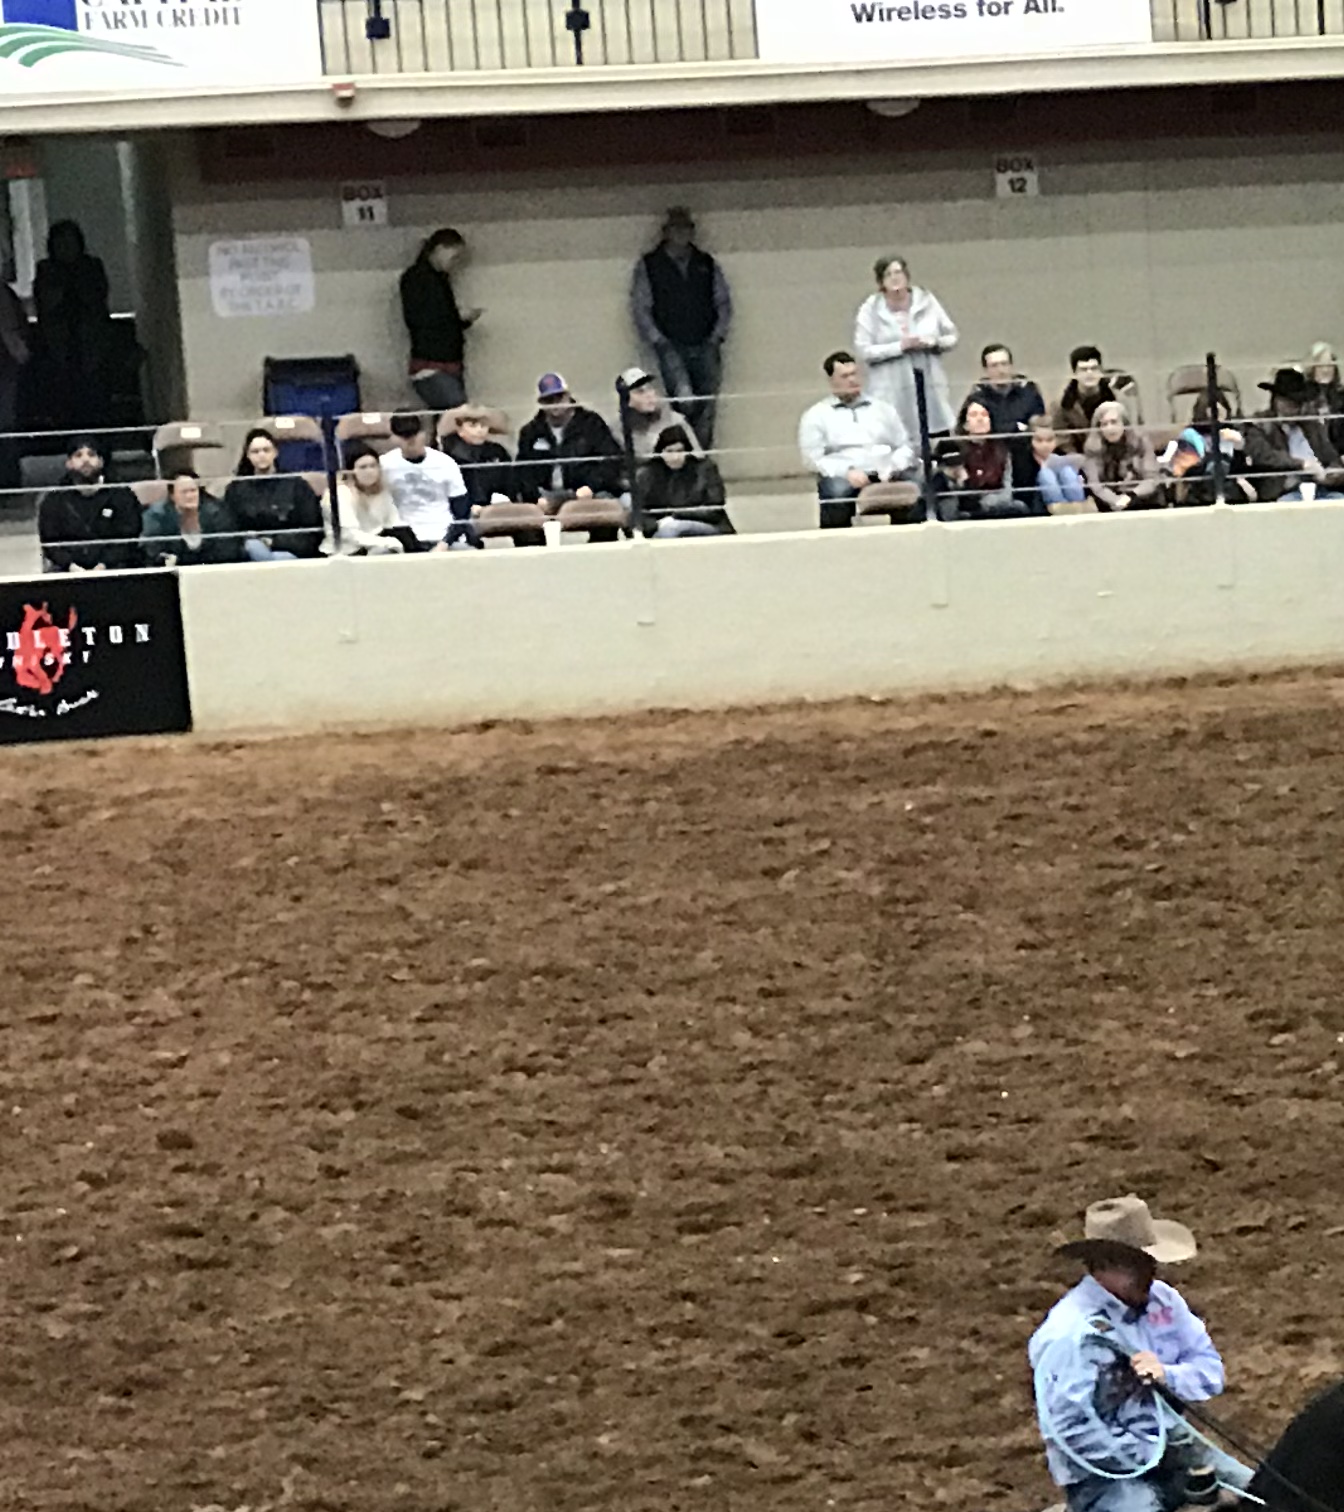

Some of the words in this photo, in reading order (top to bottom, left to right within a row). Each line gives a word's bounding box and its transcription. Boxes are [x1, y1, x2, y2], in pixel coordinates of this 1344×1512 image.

[84, 10, 148, 30] FARM
[156, 6, 240, 28] CREDIT
[851, 0, 967, 23] Wireless
[976, 0, 1013, 16] for
[1023, 0, 1065, 15] All.
[996, 157, 1034, 174] BOX
[342, 185, 383, 202] BOX
[1008, 177, 1028, 194] 12
